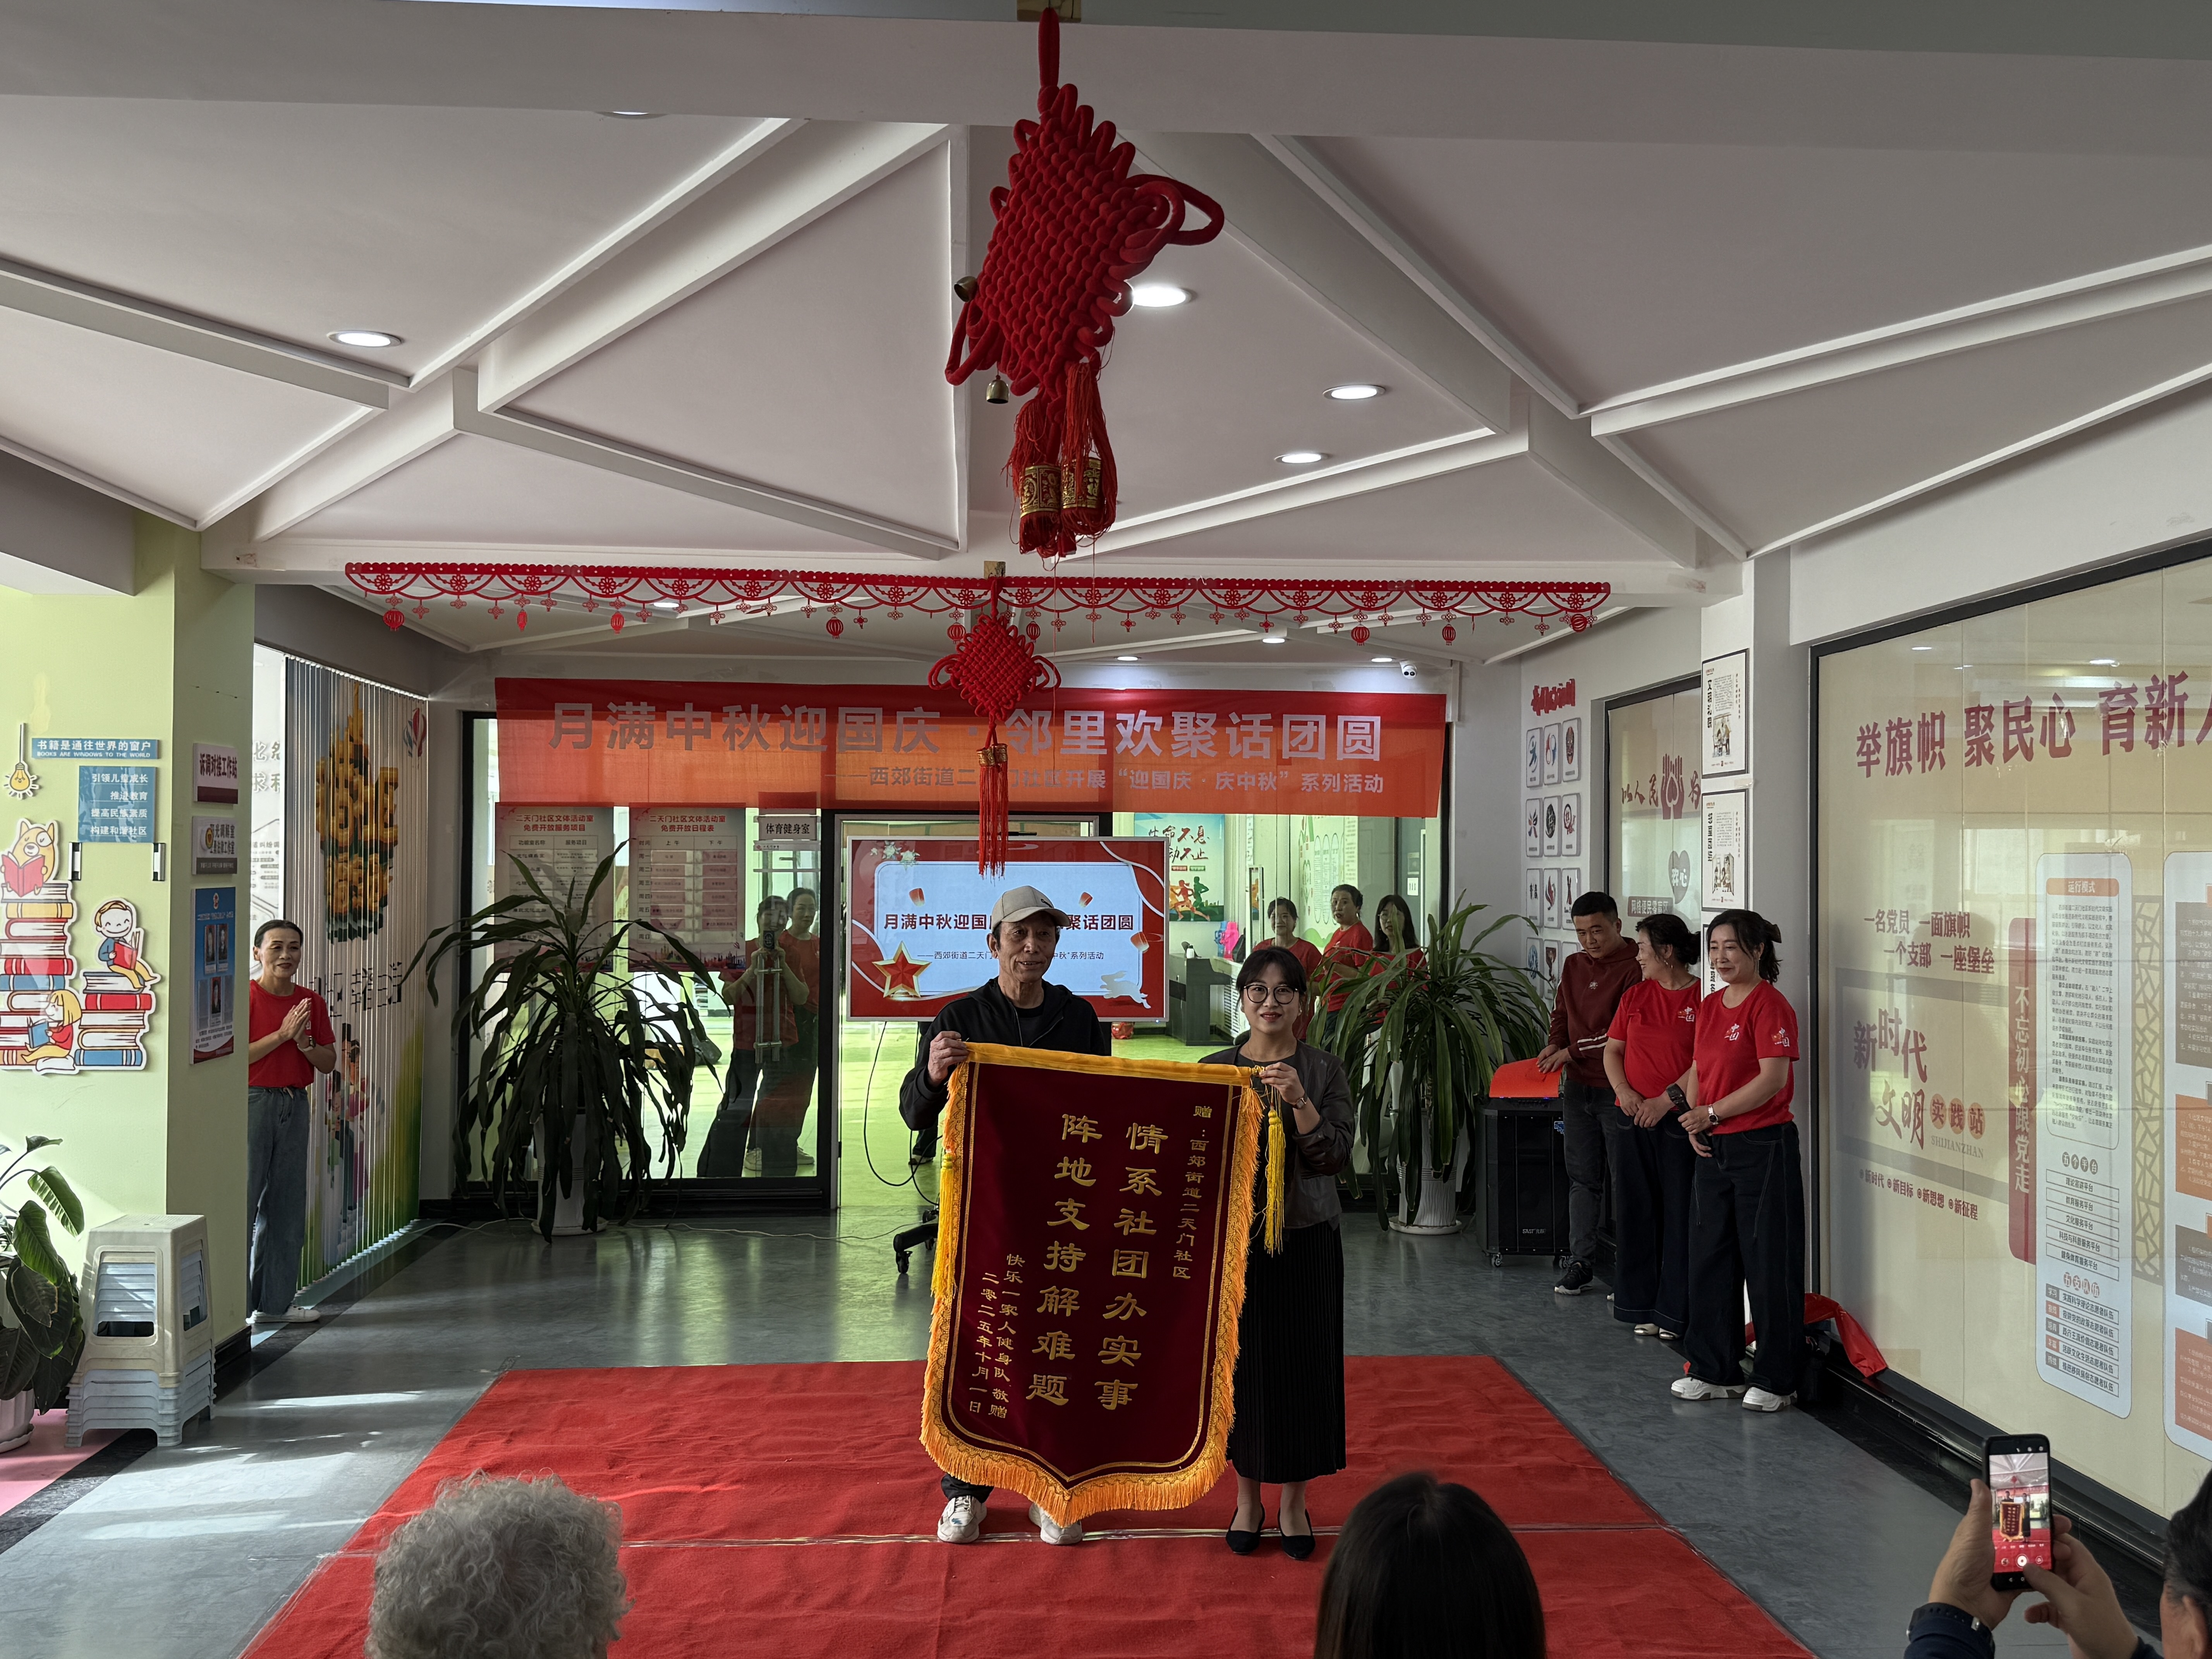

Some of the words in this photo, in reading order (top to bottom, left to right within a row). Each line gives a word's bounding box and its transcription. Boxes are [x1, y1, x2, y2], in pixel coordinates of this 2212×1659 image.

[38, 740, 151, 751] 书籍是通往世界的窗户
[1856, 710, 1946, 778] 举旗帜
[1964, 692, 2076, 767] 聚民心
[199, 753, 237, 778] 诉调对接工作站
[92, 774, 148, 783] 引领儿童成长
[1621, 773, 1659, 807] 以人民
[110, 792, 148, 800] 推进教育
[91, 809, 147, 817] 提高民族素质
[91, 826, 147, 835] 构建和谐社区
[766, 823, 810, 834] 体育健身室
[2068, 881, 2095, 893] 运行模式
[884, 914, 992, 930] 月满中秋迎国
[1863, 909, 1910, 935] 一名党员
[1918, 911, 1970, 938] 一面旗帜
[1884, 941, 1932, 968] 一个支部
[1941, 945, 1994, 974] 一座堡垒
[1853, 1007, 1927, 1083] 新时代
[2014, 986, 2030, 1194] 不忘初心跟党走
[1875, 1079, 1925, 1150] 文明
[1931, 1099, 1985, 1135] 实践站
[1931, 1135, 1984, 1158] SHIJIANZHAN
[2063, 1153, 2097, 1173] 五个平台
[1865, 1169, 1885, 1189] 新时代
[1893, 1178, 1914, 1198] 新目标
[1922, 1187, 1945, 1209] 新思想
[1954, 1197, 1978, 1221] 新征程
[2066, 1177, 2093, 1192] 理论宣讲平台
[2066, 1196, 2093, 1211] 教育服务平台
[2066, 1215, 2093, 1230] 文化服务平台
[1026, 1113, 1102, 1406] 阵地支持解难题
[1095, 1122, 1168, 1410] 情系社团办实事
[2061, 1250, 2097, 1270] 健身体育服务平台
[2064, 1273, 2099, 1298] 五支队伍
[969, 1273, 999, 1414] 二零二五年十月一日
[988, 1253, 1025, 1419] 快乐一家人健身队敬赠
